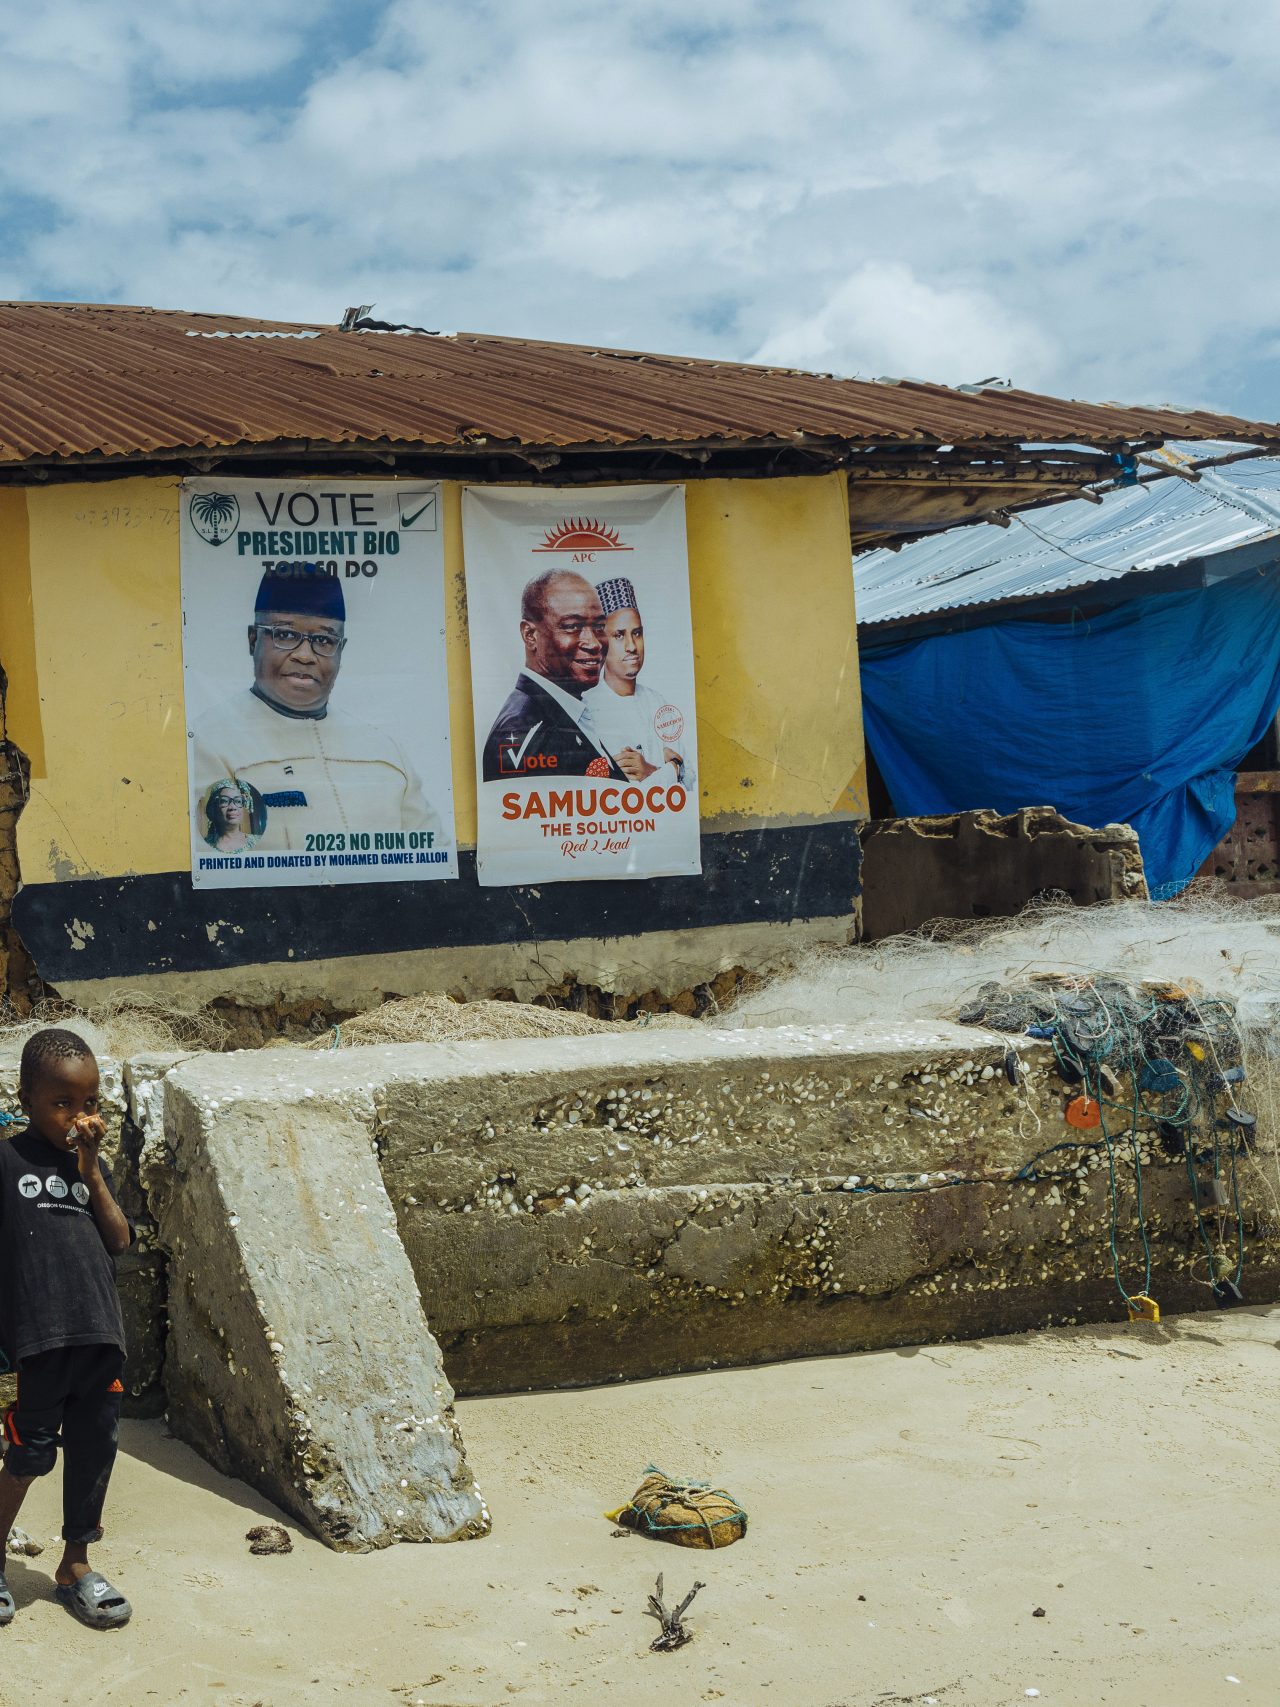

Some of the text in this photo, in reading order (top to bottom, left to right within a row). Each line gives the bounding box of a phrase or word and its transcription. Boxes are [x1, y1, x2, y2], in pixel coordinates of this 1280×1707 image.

[255, 492, 378, 526] VOTE
[238, 531, 400, 556] PRESIDENT BIO
[572, 552, 597, 562] APC
[345, 560, 378, 578] DO
[502, 785, 686, 820] SAMUCOCO
[541, 819, 655, 837] THE SOLUTION
[306, 832, 434, 852] 2023 NO RUN OFF
[561, 839, 589, 858] Red
[602, 837, 630, 853] Lead
[199, 852, 448, 870] PRINTED AND DONATED BY MOHAMED GAWEE JALLOH
